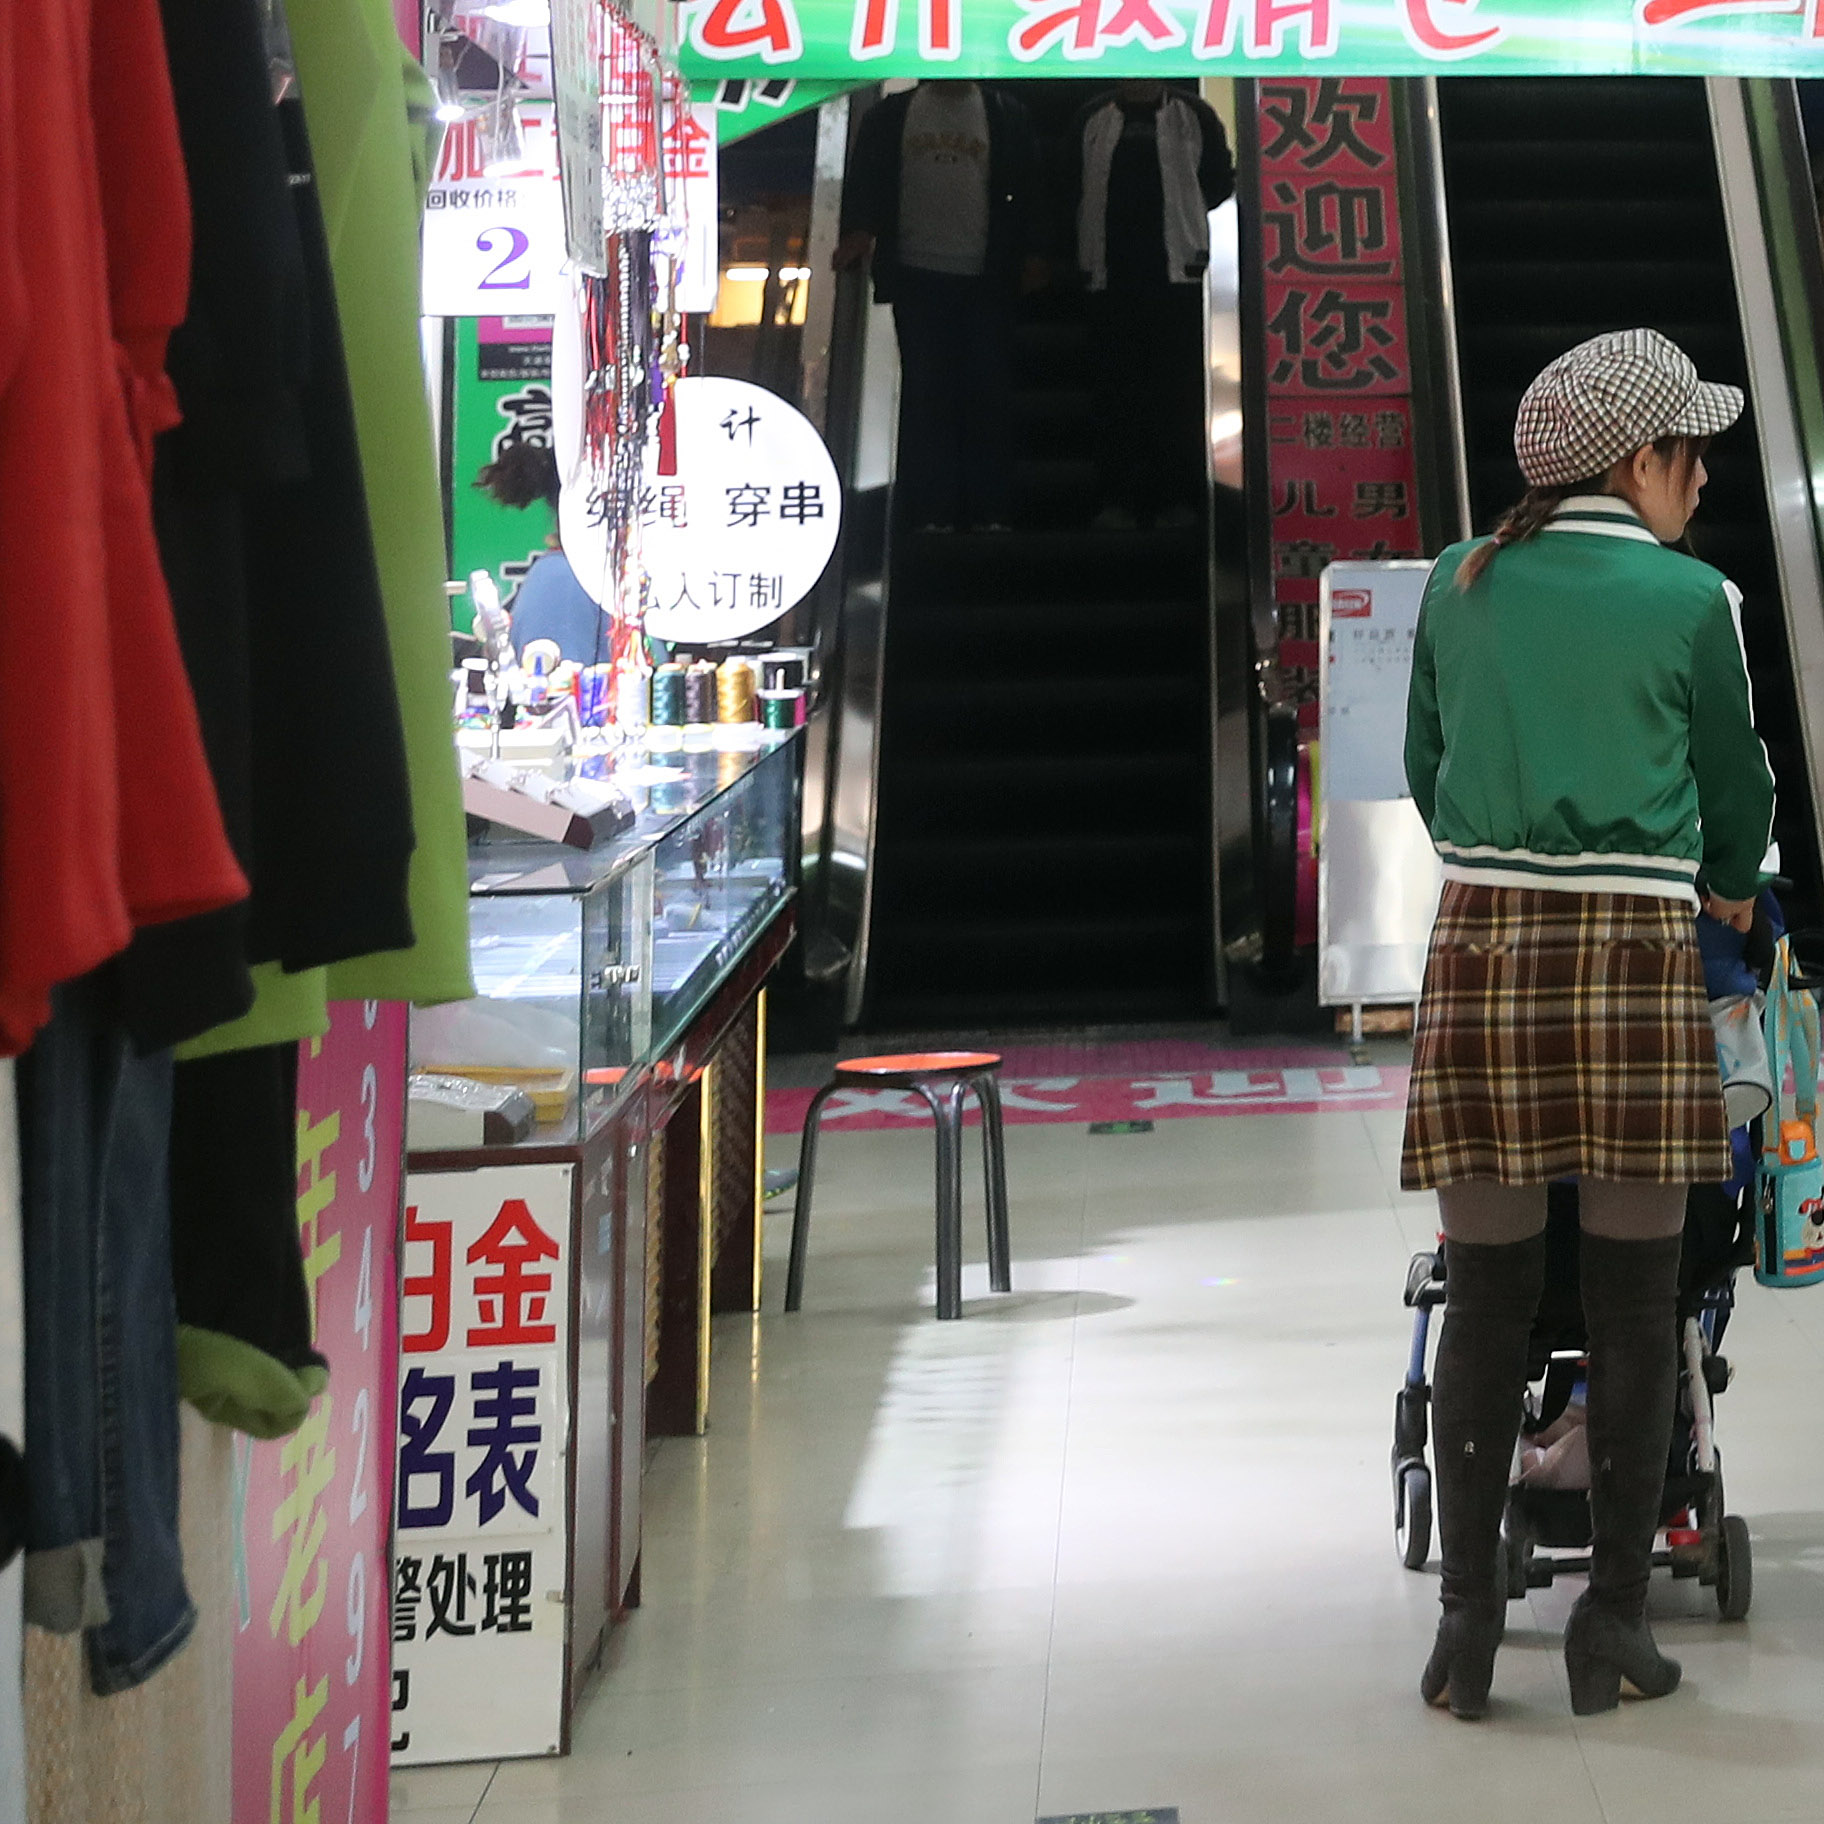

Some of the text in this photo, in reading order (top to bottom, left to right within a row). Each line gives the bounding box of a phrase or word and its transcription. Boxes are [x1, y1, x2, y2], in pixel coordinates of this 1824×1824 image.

[476, 226, 532, 290] 2
[1262, 77, 1401, 390] 欢迎您
[1269, 409, 1406, 449] 二楼经营
[725, 481, 825, 528] 穿串
